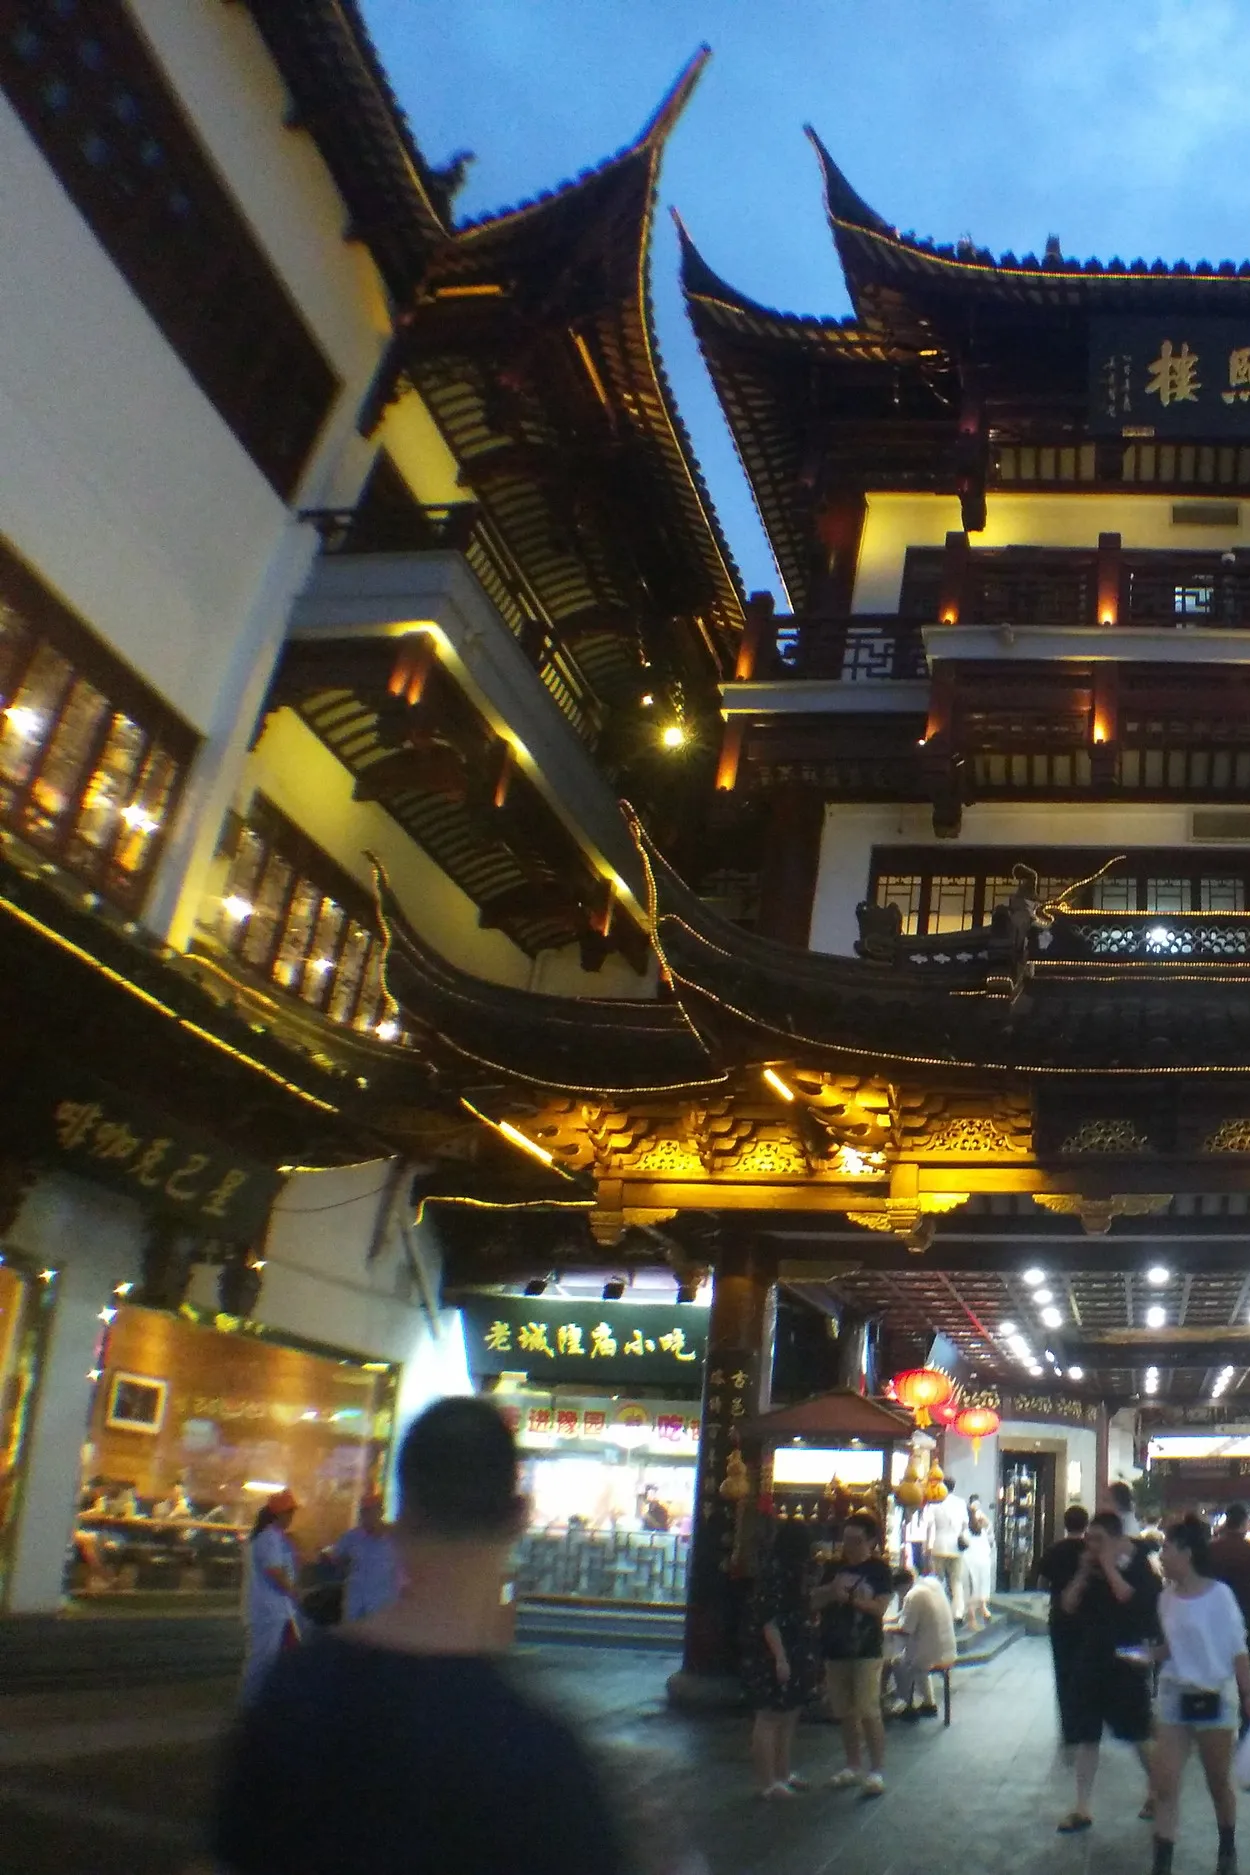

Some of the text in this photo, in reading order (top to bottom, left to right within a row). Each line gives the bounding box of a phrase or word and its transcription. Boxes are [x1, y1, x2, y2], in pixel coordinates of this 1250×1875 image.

[484, 1320, 697, 1362] 老城隍庙小吃
